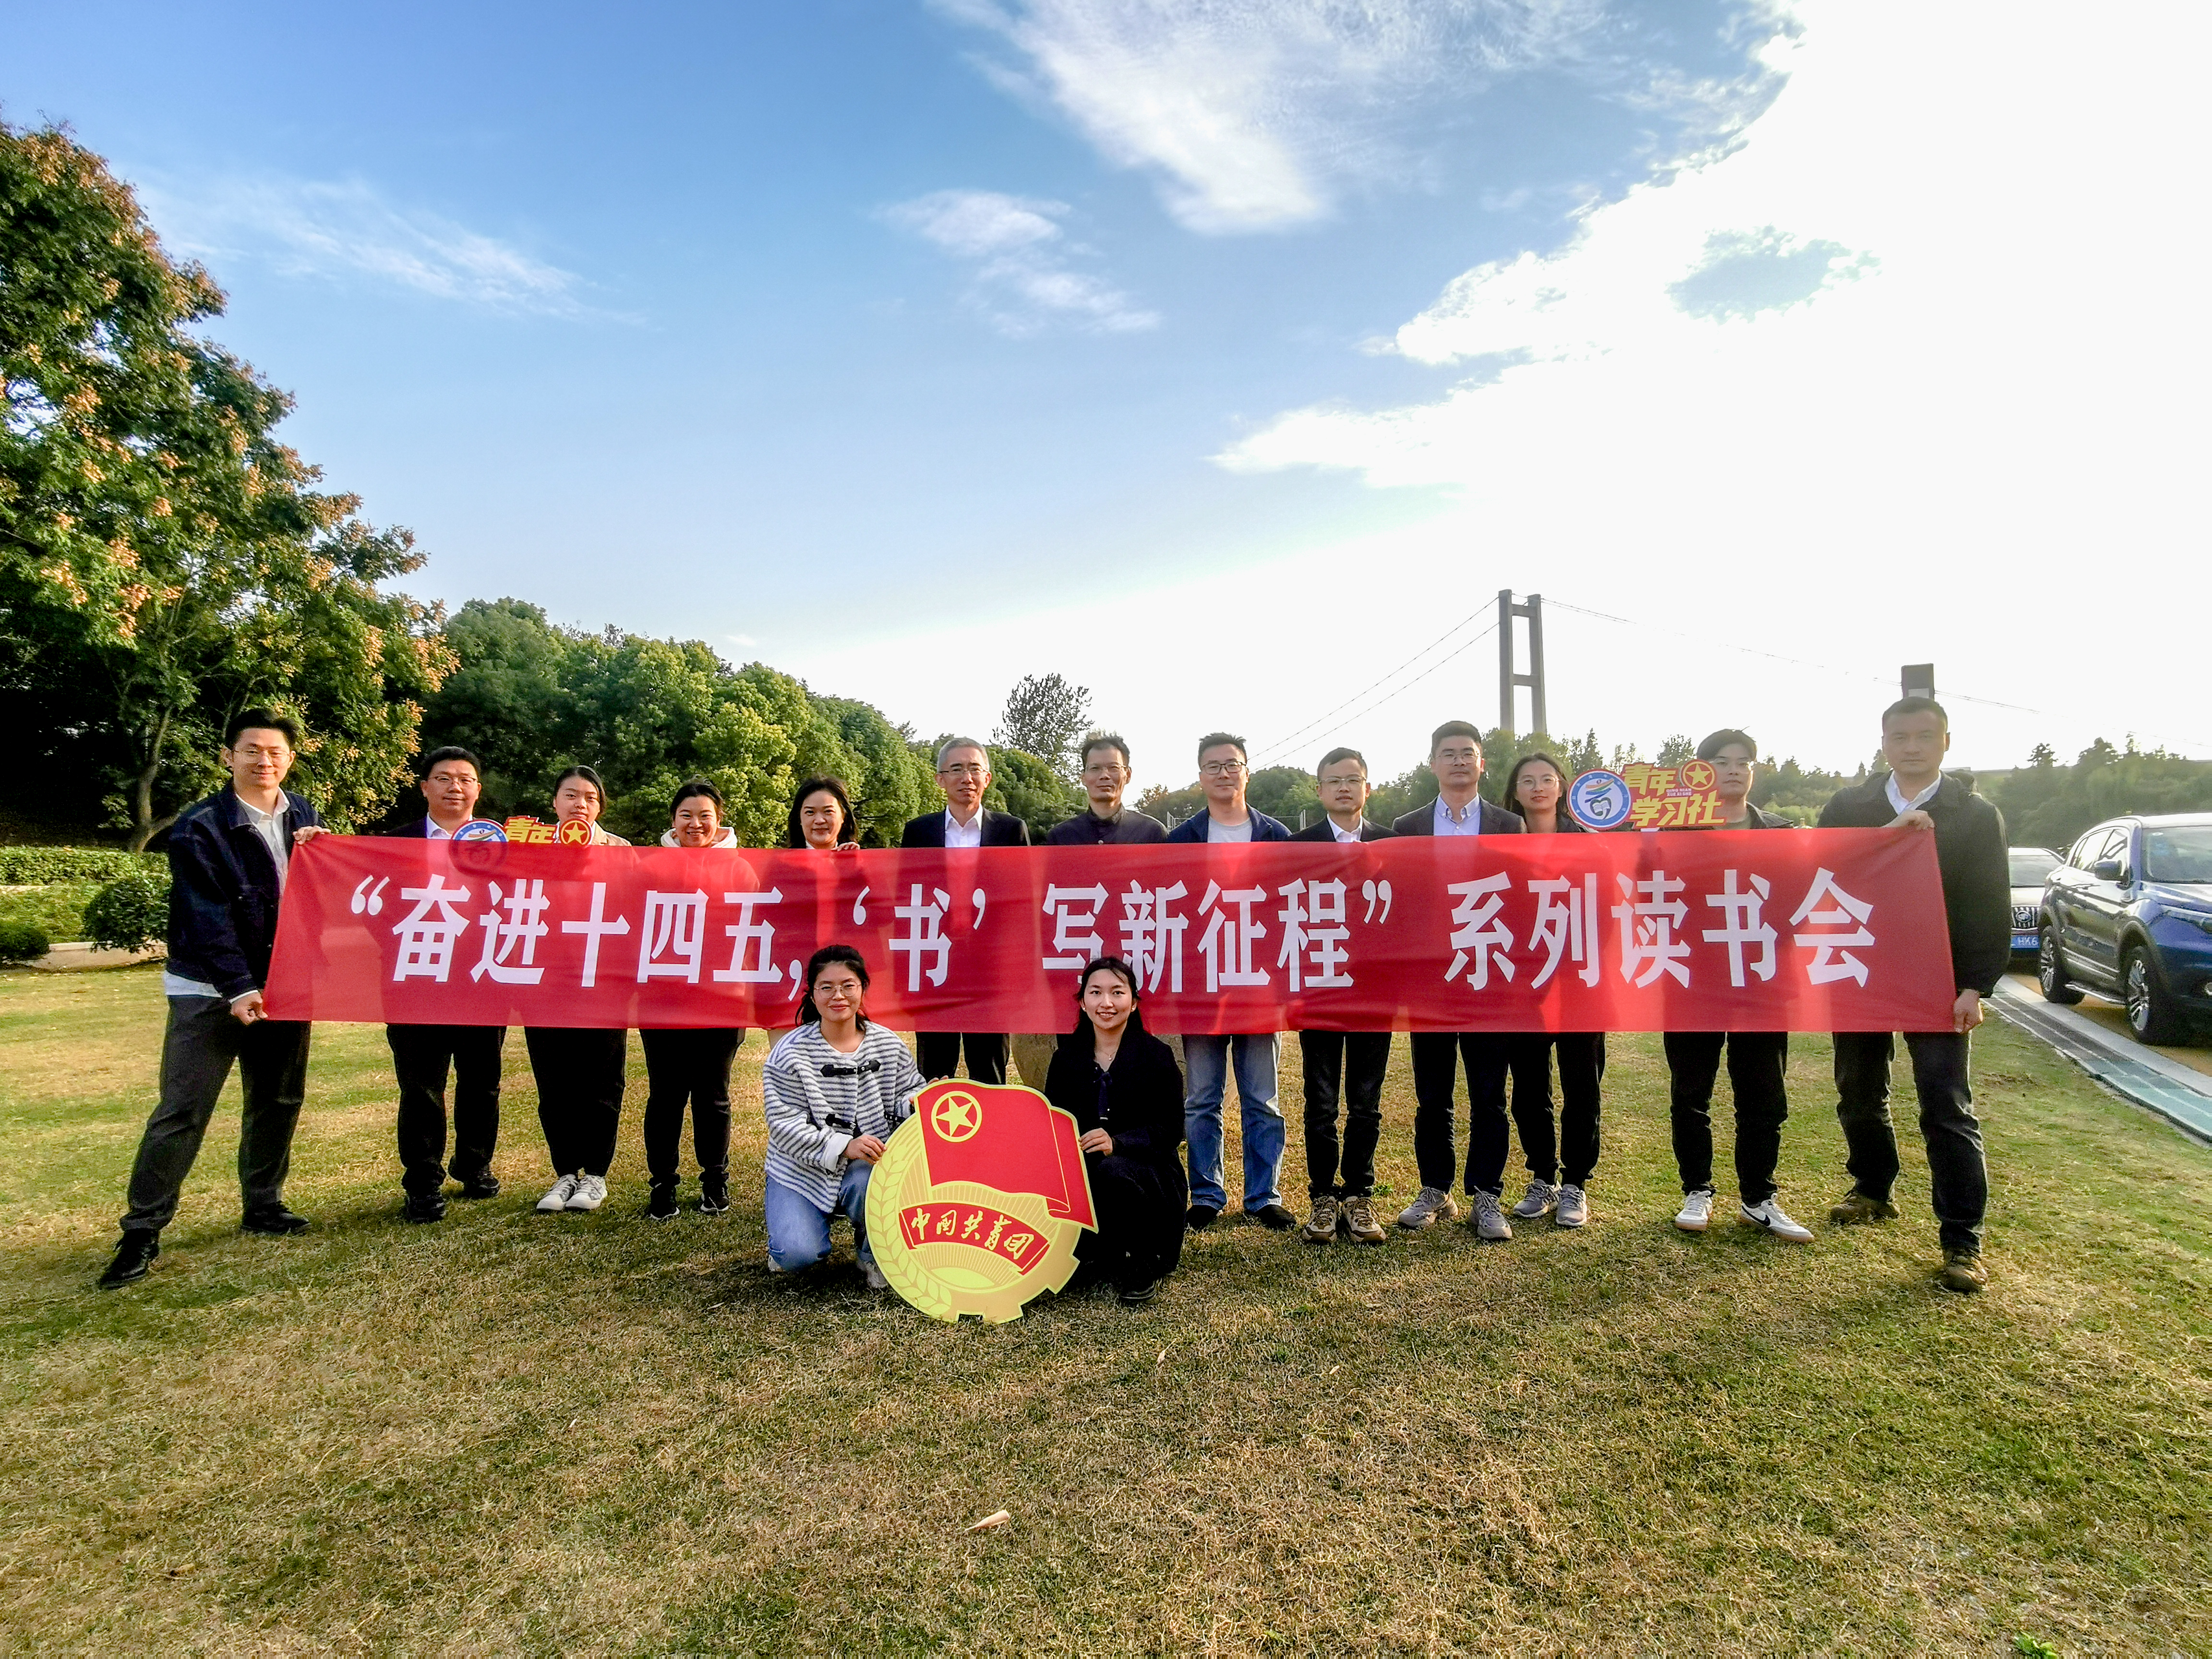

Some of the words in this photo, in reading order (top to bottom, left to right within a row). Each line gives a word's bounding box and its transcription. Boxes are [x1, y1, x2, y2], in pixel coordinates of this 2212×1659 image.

[1623, 764, 1676, 796] 青年
[1629, 789, 1725, 826] 学习社
[505, 818, 555, 843] 青年
